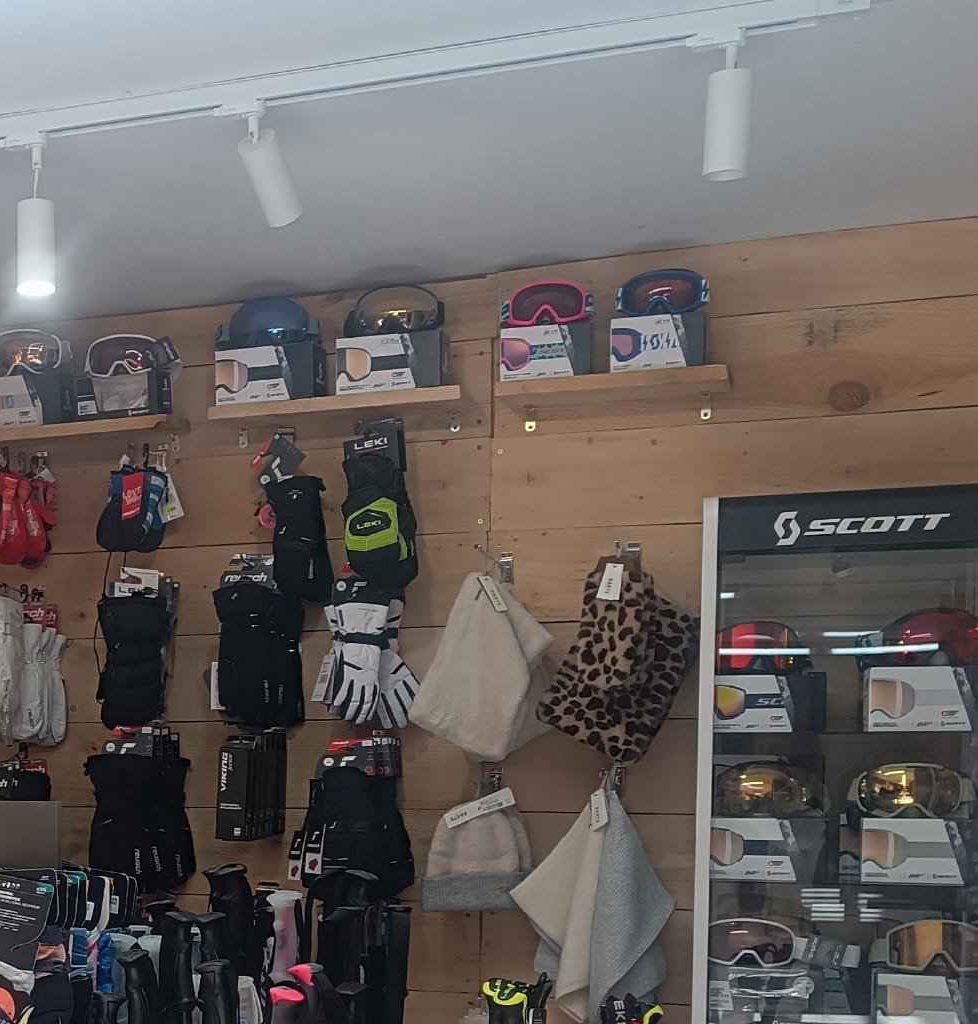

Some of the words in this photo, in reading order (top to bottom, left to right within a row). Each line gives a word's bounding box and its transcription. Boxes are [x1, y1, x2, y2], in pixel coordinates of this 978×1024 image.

[354, 437, 388, 450] LEKI
[356, 520, 382, 530] LEKI
[804, 513, 950, 535] SCOTT
[220, 752, 228, 792] VIKING
